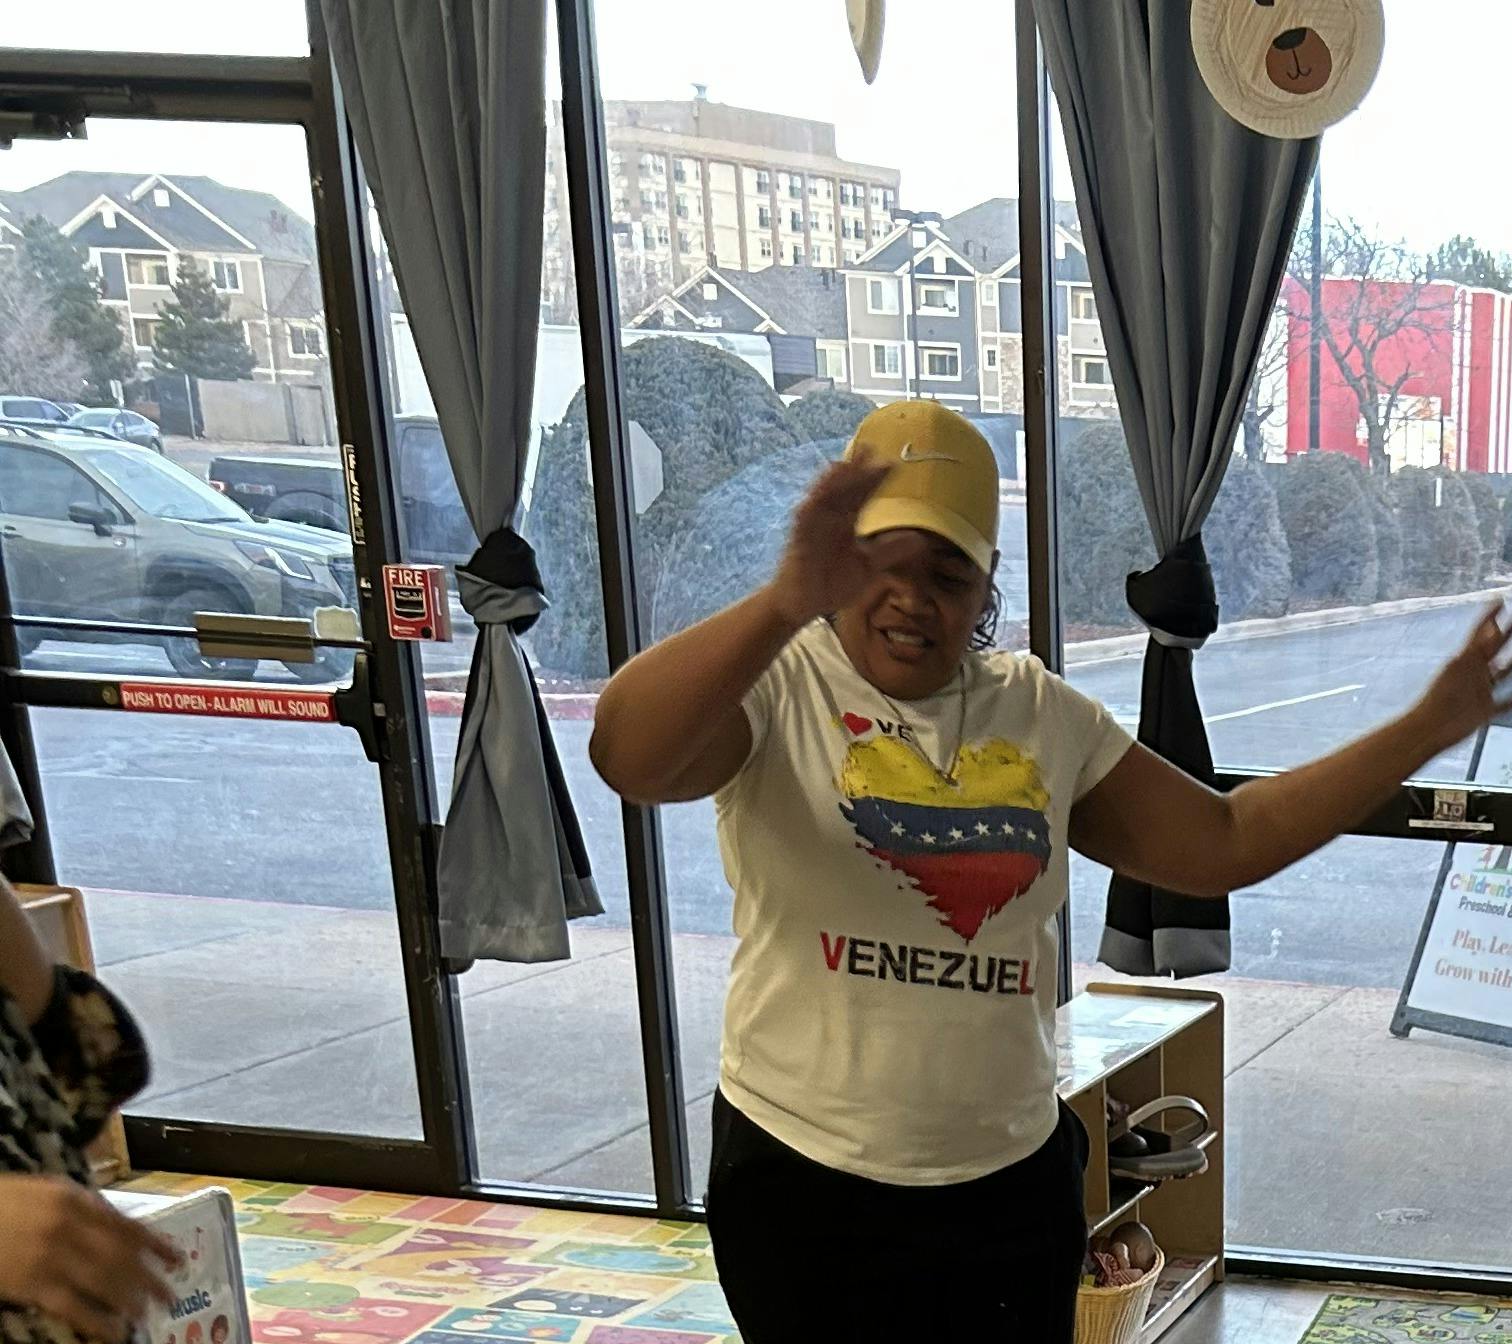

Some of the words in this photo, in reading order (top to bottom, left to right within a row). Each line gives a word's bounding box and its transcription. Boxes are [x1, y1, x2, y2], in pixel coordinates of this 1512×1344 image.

[388, 568, 425, 586] FIRE
[122, 690, 154, 708] PUSH
[156, 692, 173, 709] TO
[174, 695, 208, 712] OPEN
[213, 696, 256, 714] ALARM
[258, 699, 287, 716] WILL
[289, 701, 330, 719] SOUND
[1458, 896, 1507, 917] Preschool
[1434, 958, 1474, 981] Grow
